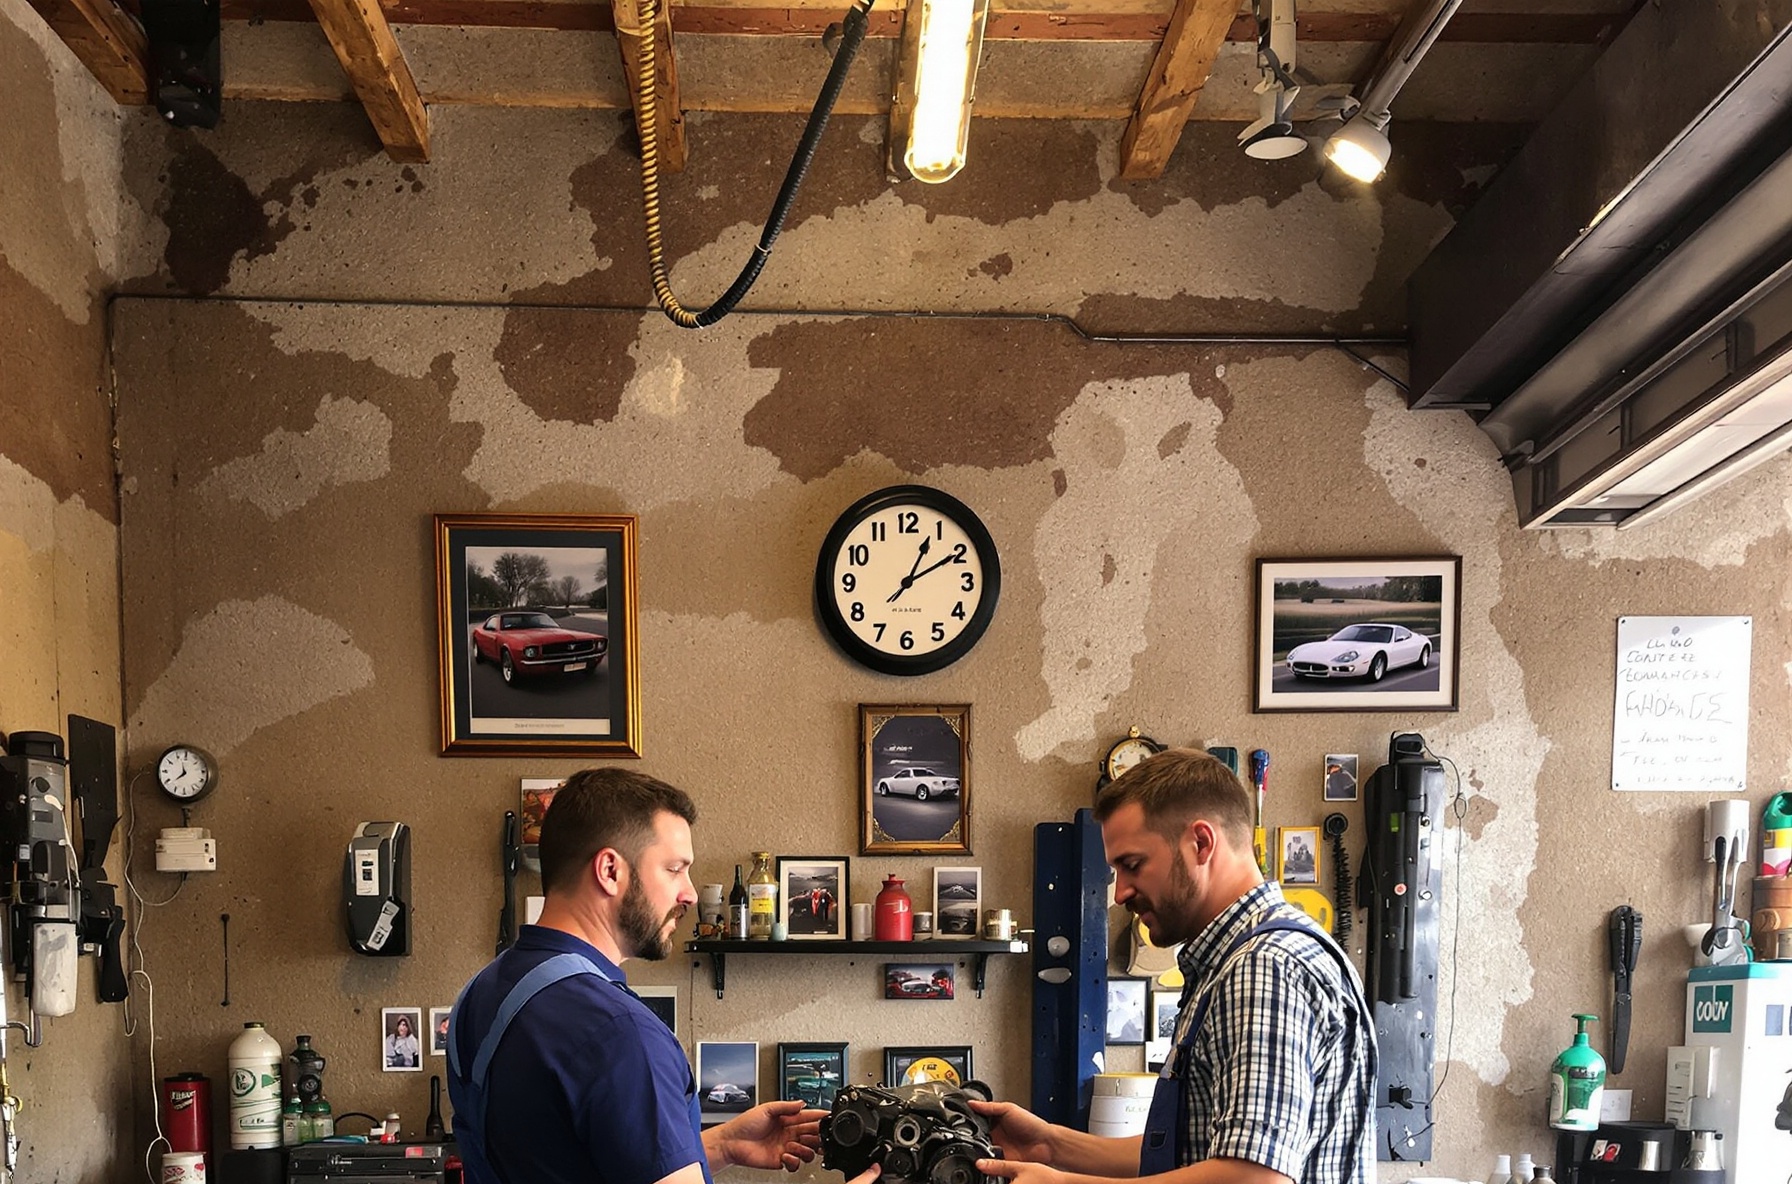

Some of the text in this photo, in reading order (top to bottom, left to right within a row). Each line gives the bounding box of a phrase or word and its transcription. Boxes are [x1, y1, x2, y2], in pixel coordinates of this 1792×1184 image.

[871, 522, 885, 541] 11
[898, 512, 919, 533] 12
[936, 520, 942, 540] 1
[848, 544, 869, 566] 10
[953, 544, 967, 563] 2
[842, 573, 856, 593] 9
[960, 572, 974, 591] 3
[850, 602, 865, 622] 8
[951, 601, 966, 620] 4
[873, 623, 887, 642] 7
[900, 631, 914, 650] 6
[931, 622, 945, 641] 5
